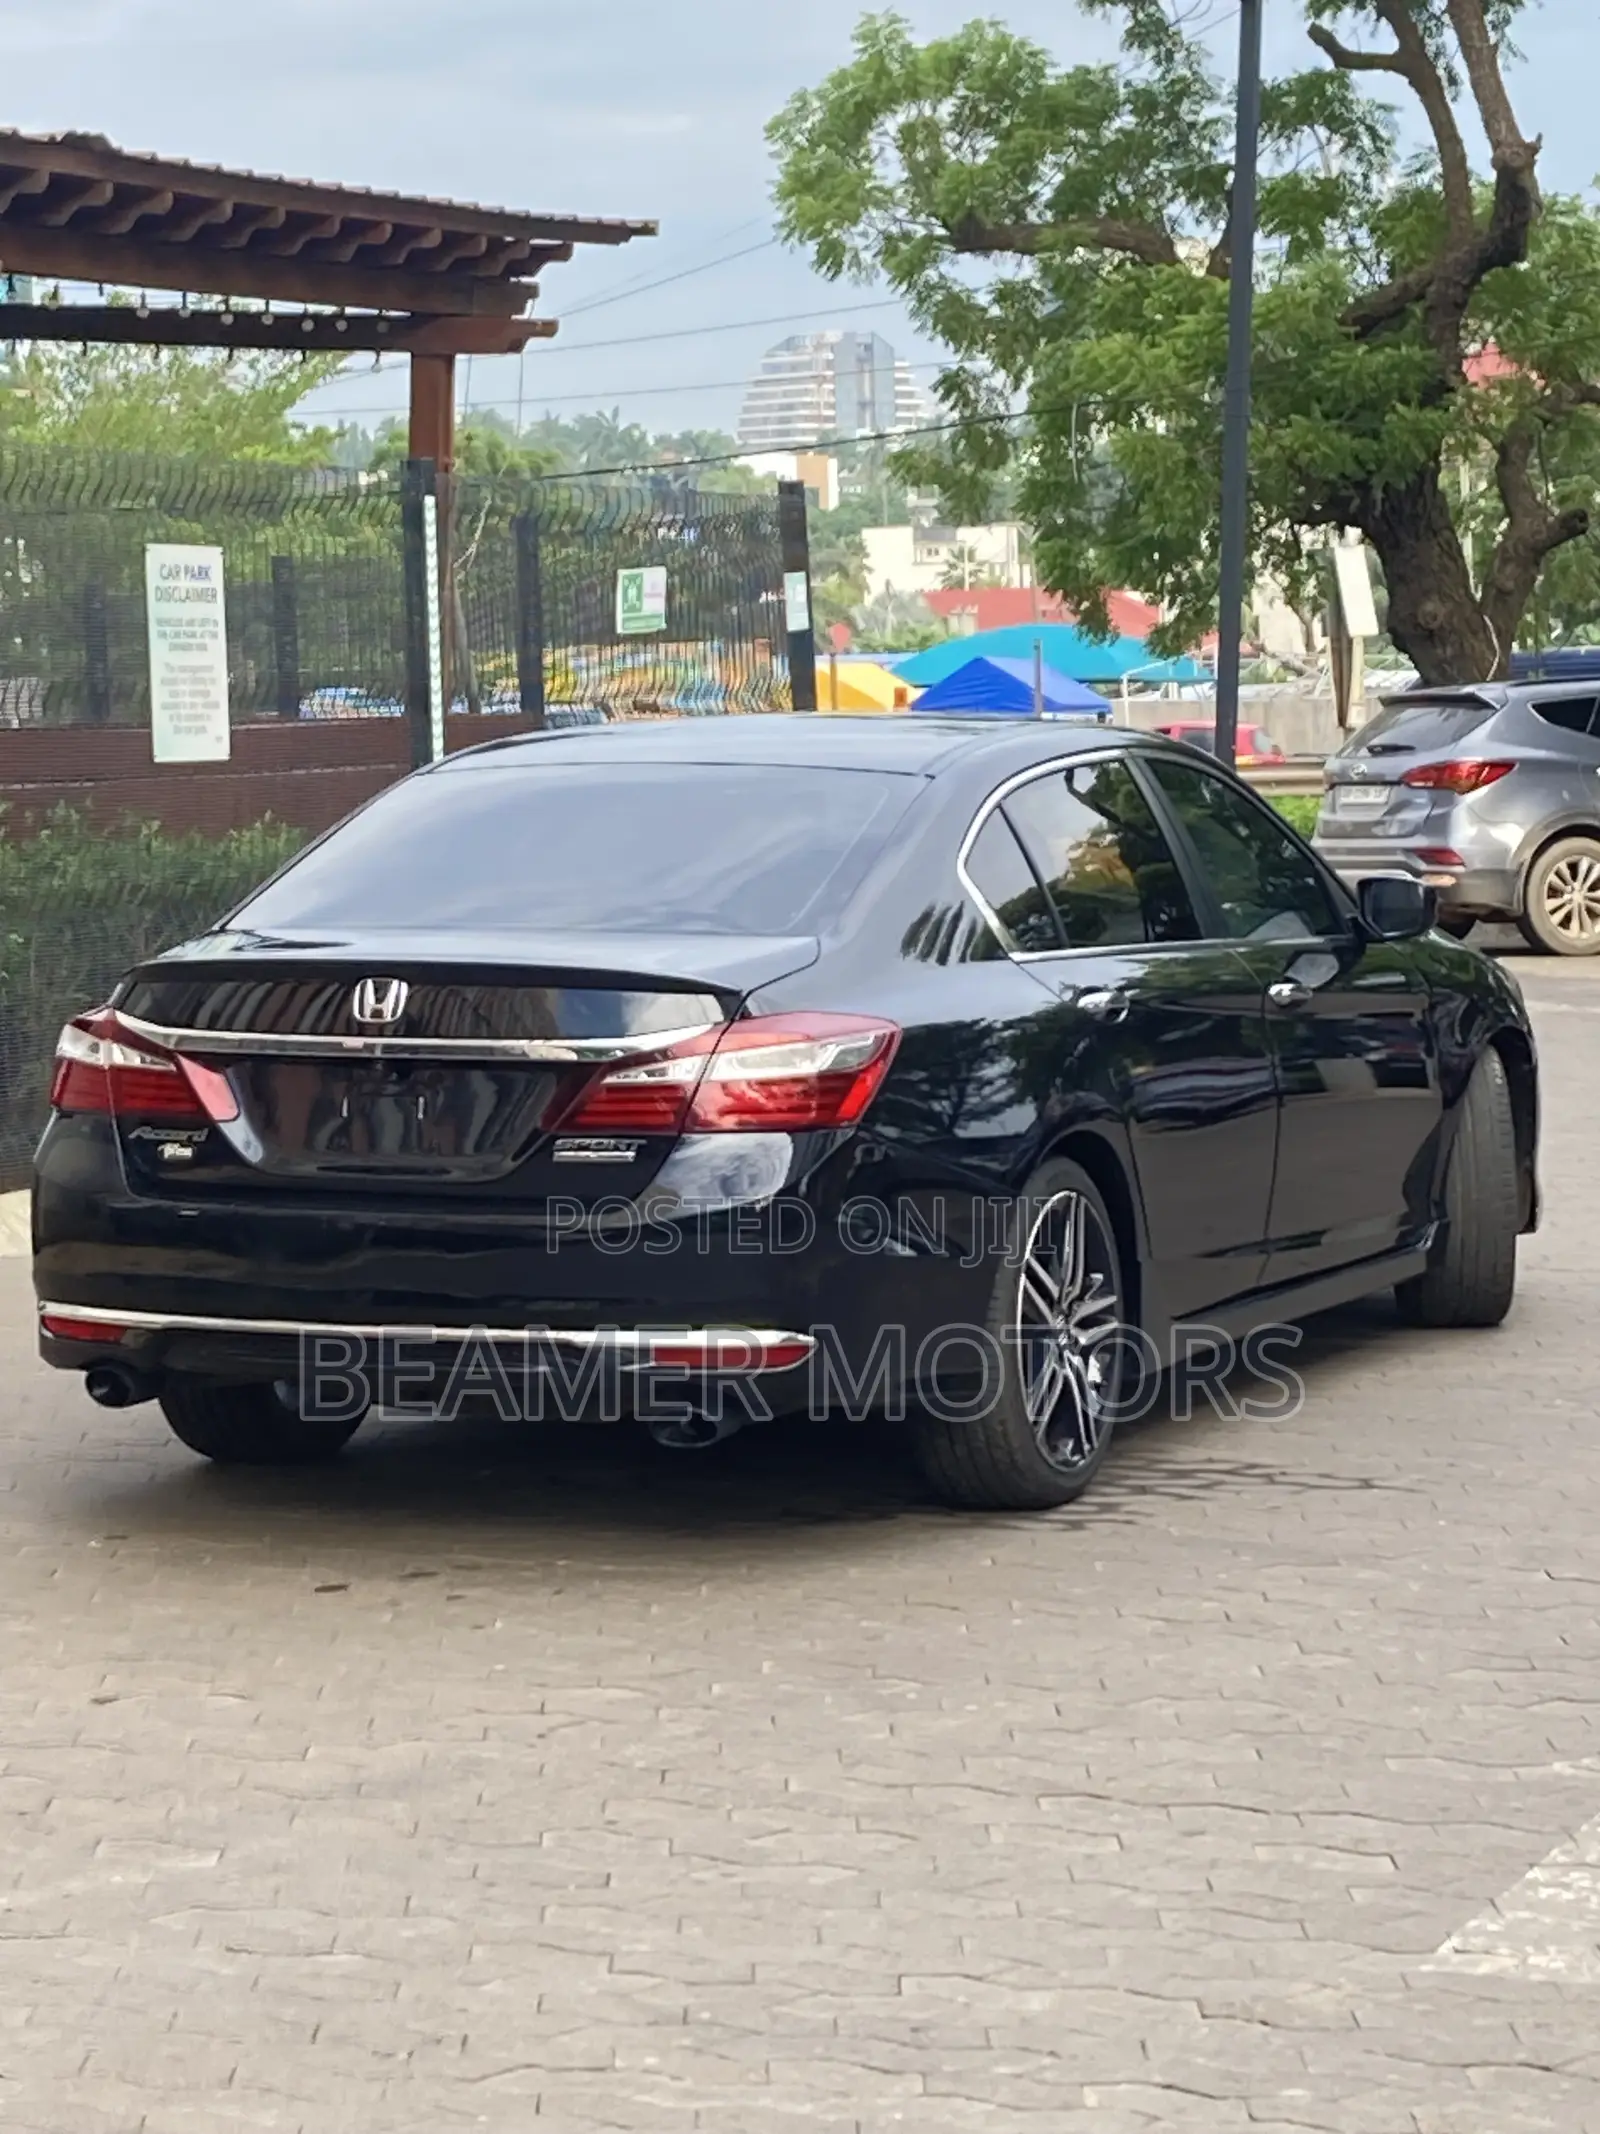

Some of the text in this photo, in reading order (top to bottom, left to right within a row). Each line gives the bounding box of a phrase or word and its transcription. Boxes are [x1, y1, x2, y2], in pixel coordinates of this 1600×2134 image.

[159, 563, 212, 582] CAR PARK
[155, 585, 218, 604] DISCLAIMER
